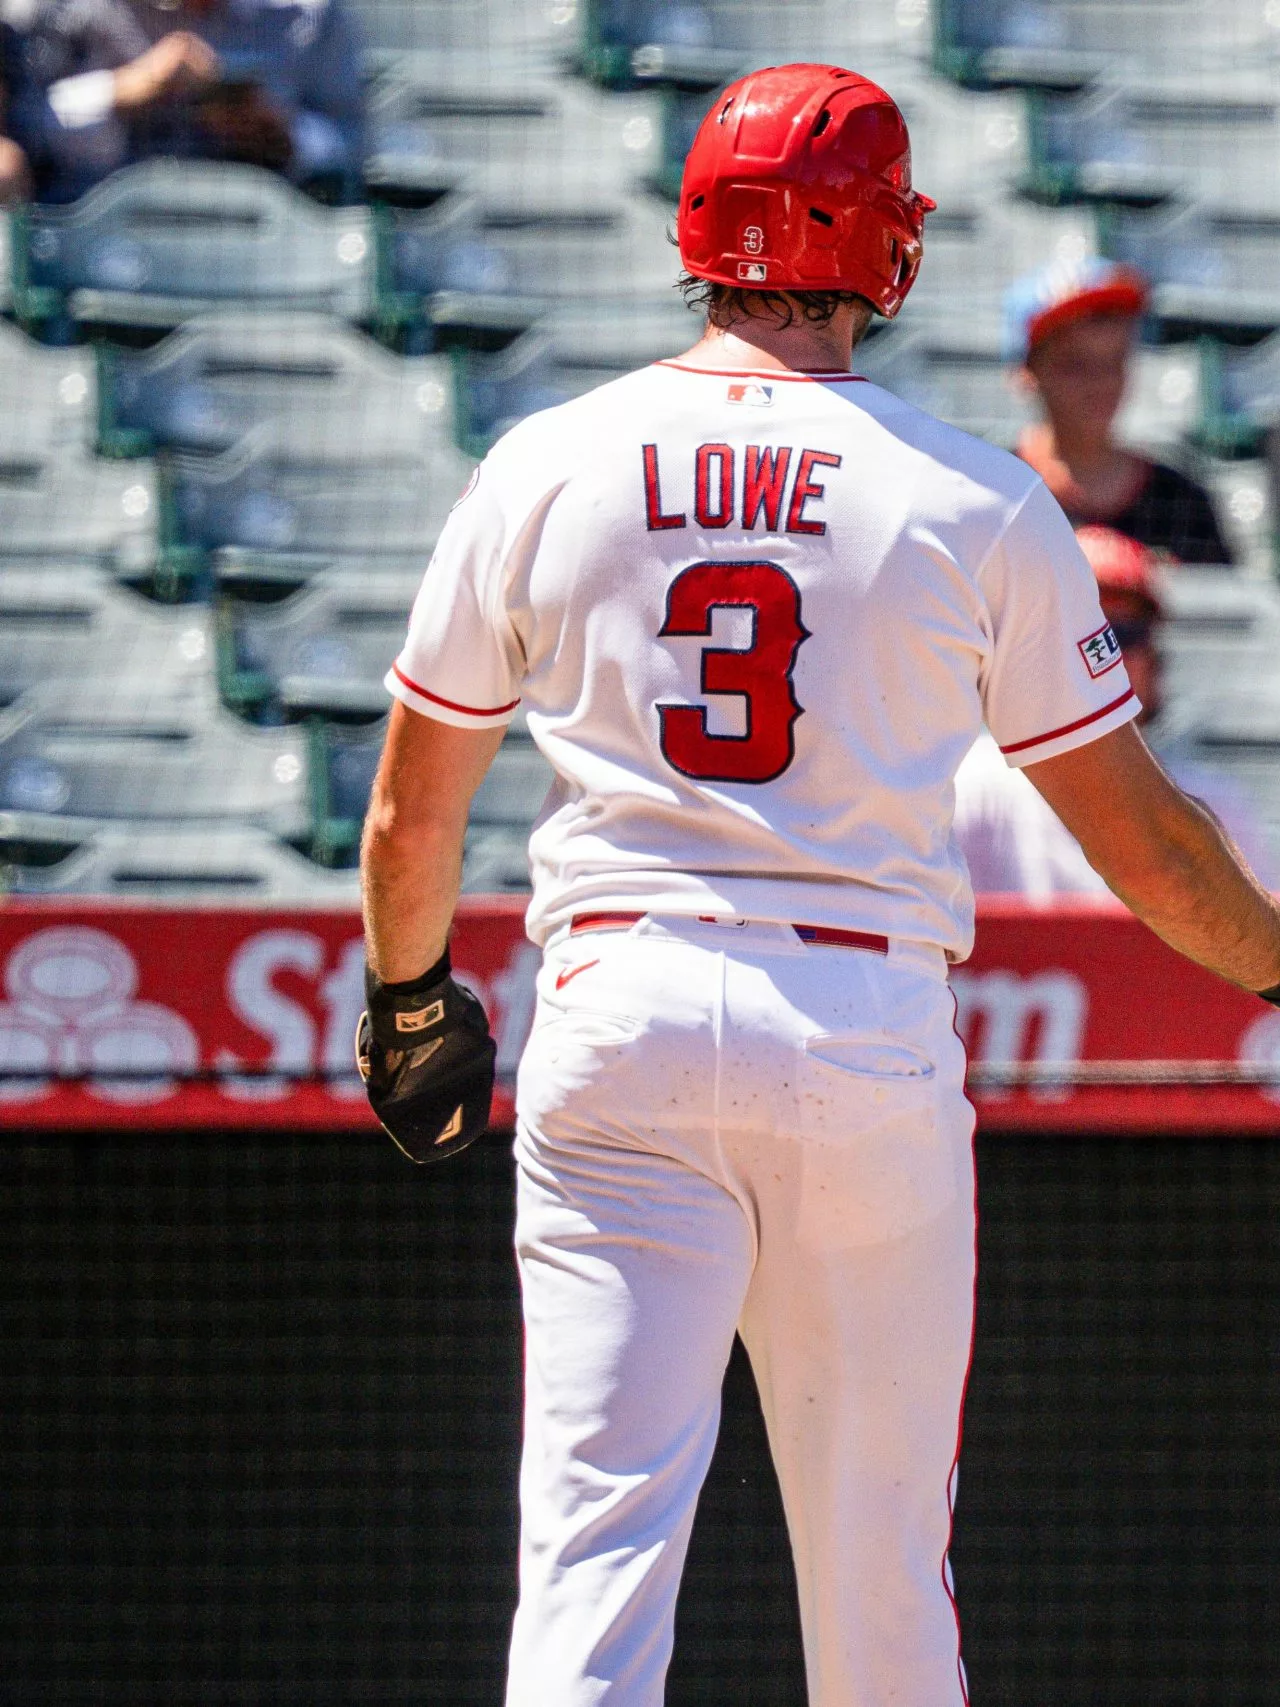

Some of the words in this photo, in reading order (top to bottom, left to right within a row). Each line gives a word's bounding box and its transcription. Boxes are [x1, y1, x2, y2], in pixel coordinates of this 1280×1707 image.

[744, 225, 764, 254] 3
[642, 443, 842, 535] LOWE
[655, 560, 812, 785] 3
